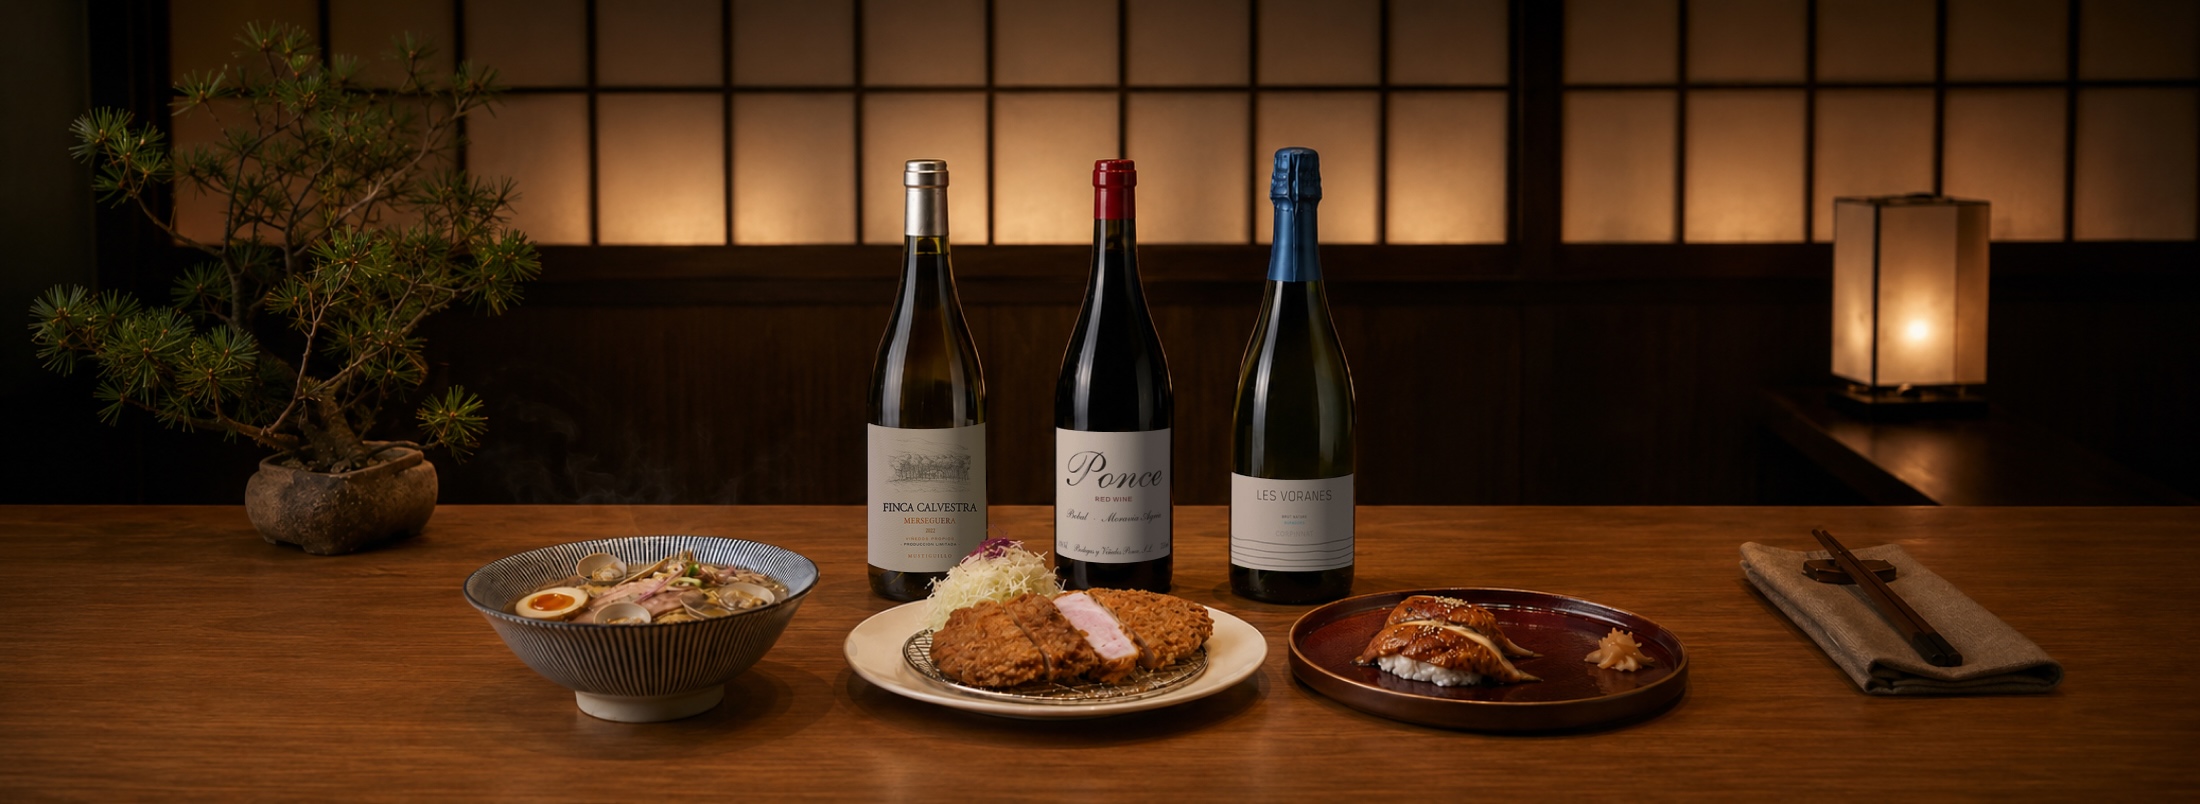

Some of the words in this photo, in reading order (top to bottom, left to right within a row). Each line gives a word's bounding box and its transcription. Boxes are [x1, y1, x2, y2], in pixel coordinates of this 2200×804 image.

[1066, 450, 1163, 489] Ponce
[1094, 495, 1111, 503] RED
[1112, 495, 1133, 503] WINE
[1256, 489, 1277, 501] LES
[1280, 489, 1333, 502] VORANES
[882, 502, 914, 513] FINCA
[916, 502, 978, 513] CALVESTRA
[903, 517, 956, 525] MERSEGUERA
